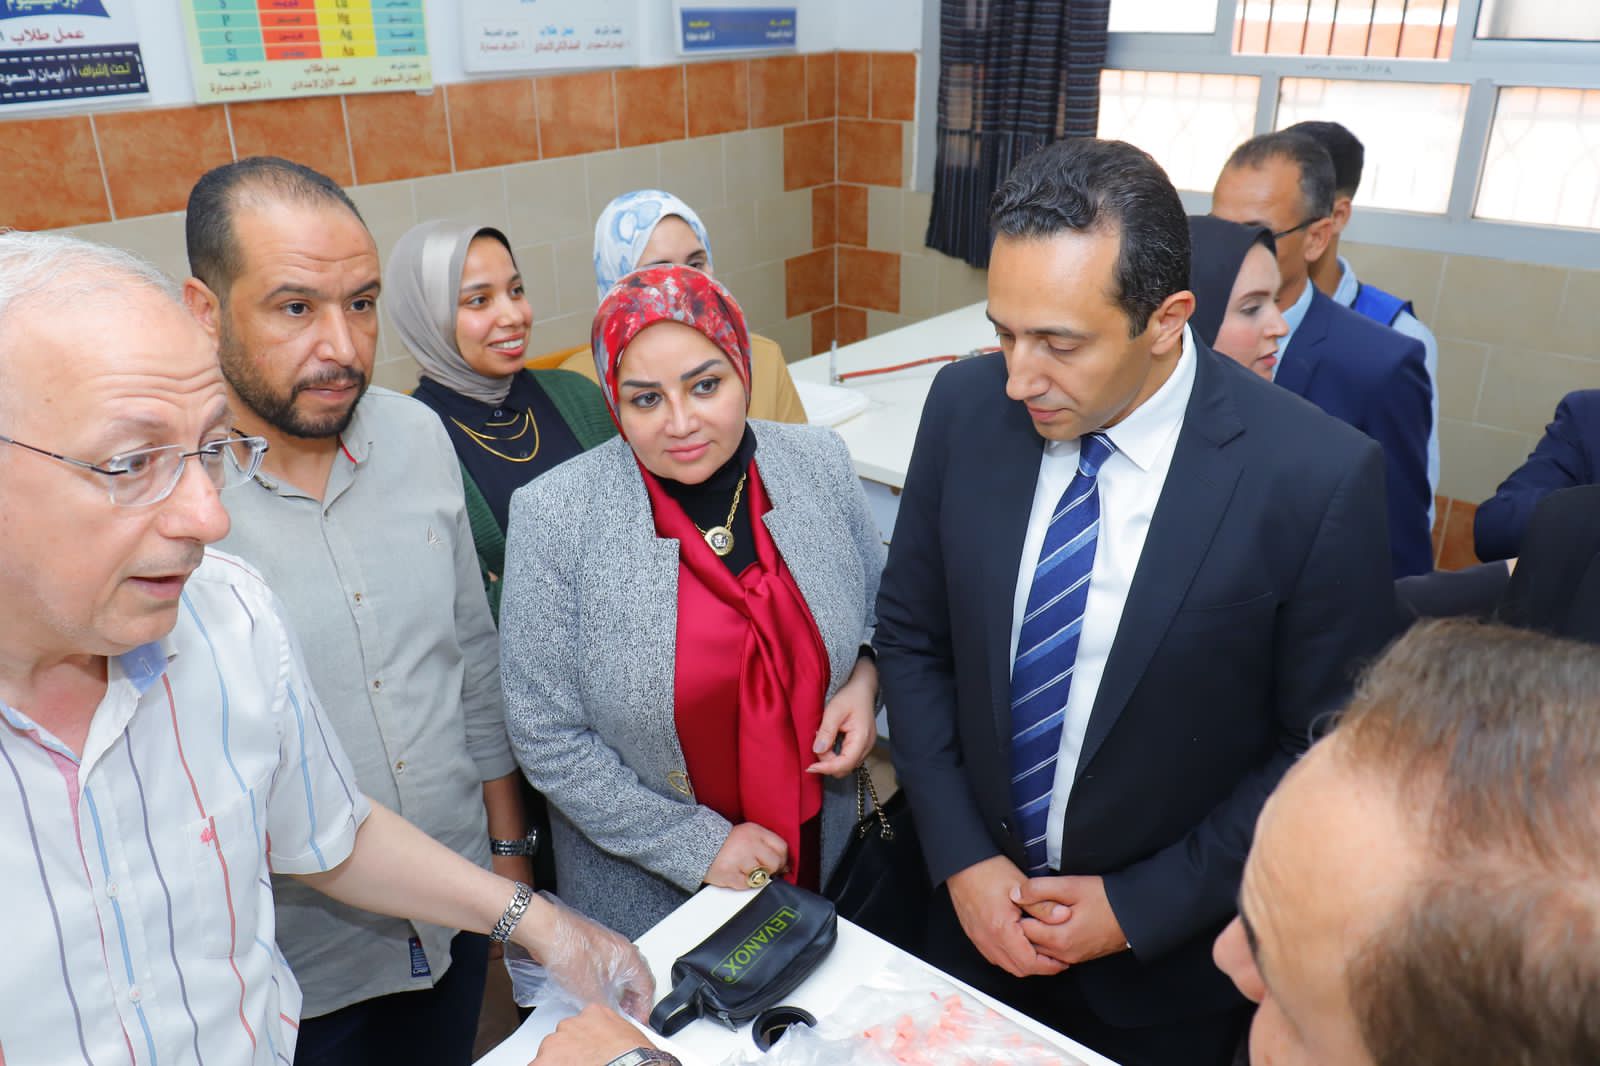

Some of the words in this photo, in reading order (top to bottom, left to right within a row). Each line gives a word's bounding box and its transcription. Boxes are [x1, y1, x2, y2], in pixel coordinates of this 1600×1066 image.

[11, 28, 50, 45] طلاب
[53, 25, 85, 43] عمل
[723, 910, 796, 976] LEVANOX
